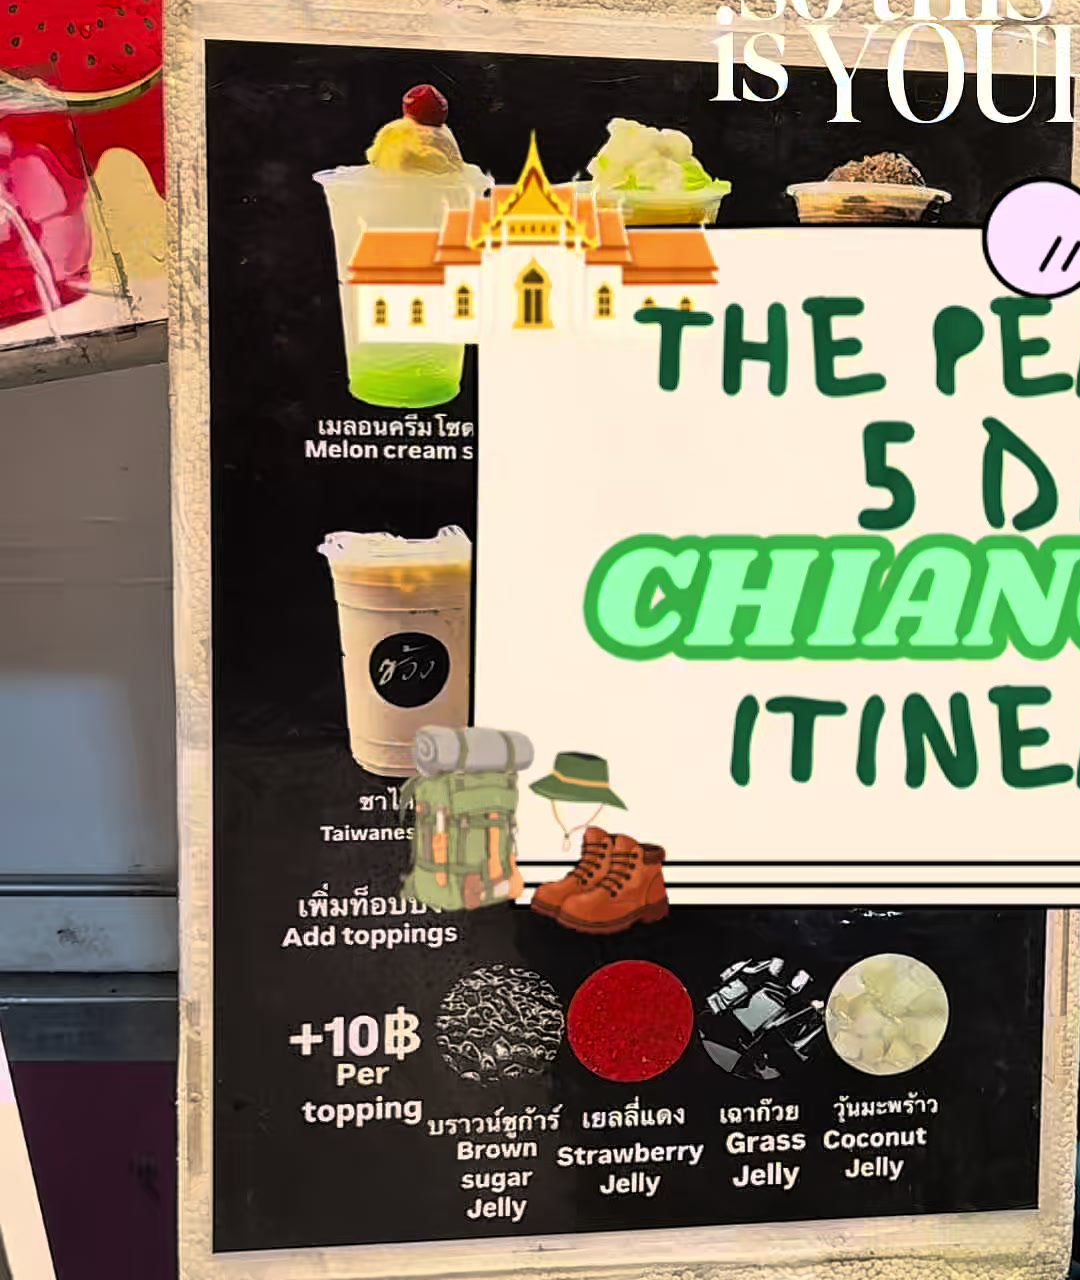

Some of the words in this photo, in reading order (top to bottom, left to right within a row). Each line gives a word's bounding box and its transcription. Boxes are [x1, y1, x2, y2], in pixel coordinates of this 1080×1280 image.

[318, 413, 432, 436] เมลอนครีม
[304, 440, 378, 458] Melon
[383, 445, 457, 459] cream
[282, 926, 335, 947] Add
[342, 923, 458, 949] toppings
[337, 1063, 390, 1086] Per
[302, 1096, 422, 1128] topping
[582, 1096, 686, 1129] เยลลี่แดง
[719, 1098, 799, 1124] เฉาก๊วย
[833, 1091, 938, 1123] วุ้นมะพร้าว
[726, 1131, 806, 1153] Grass
[823, 1127, 927, 1149] Coconut
[457, 1141, 537, 1160] Brown
[557, 1143, 703, 1166] Strawberry
[733, 1162, 800, 1190] Jelly
[845, 1156, 904, 1180] Jelly
[461, 1170, 533, 1192] sugar
[600, 1172, 661, 1197] Jelly
[466, 1196, 527, 1222] Jelly
